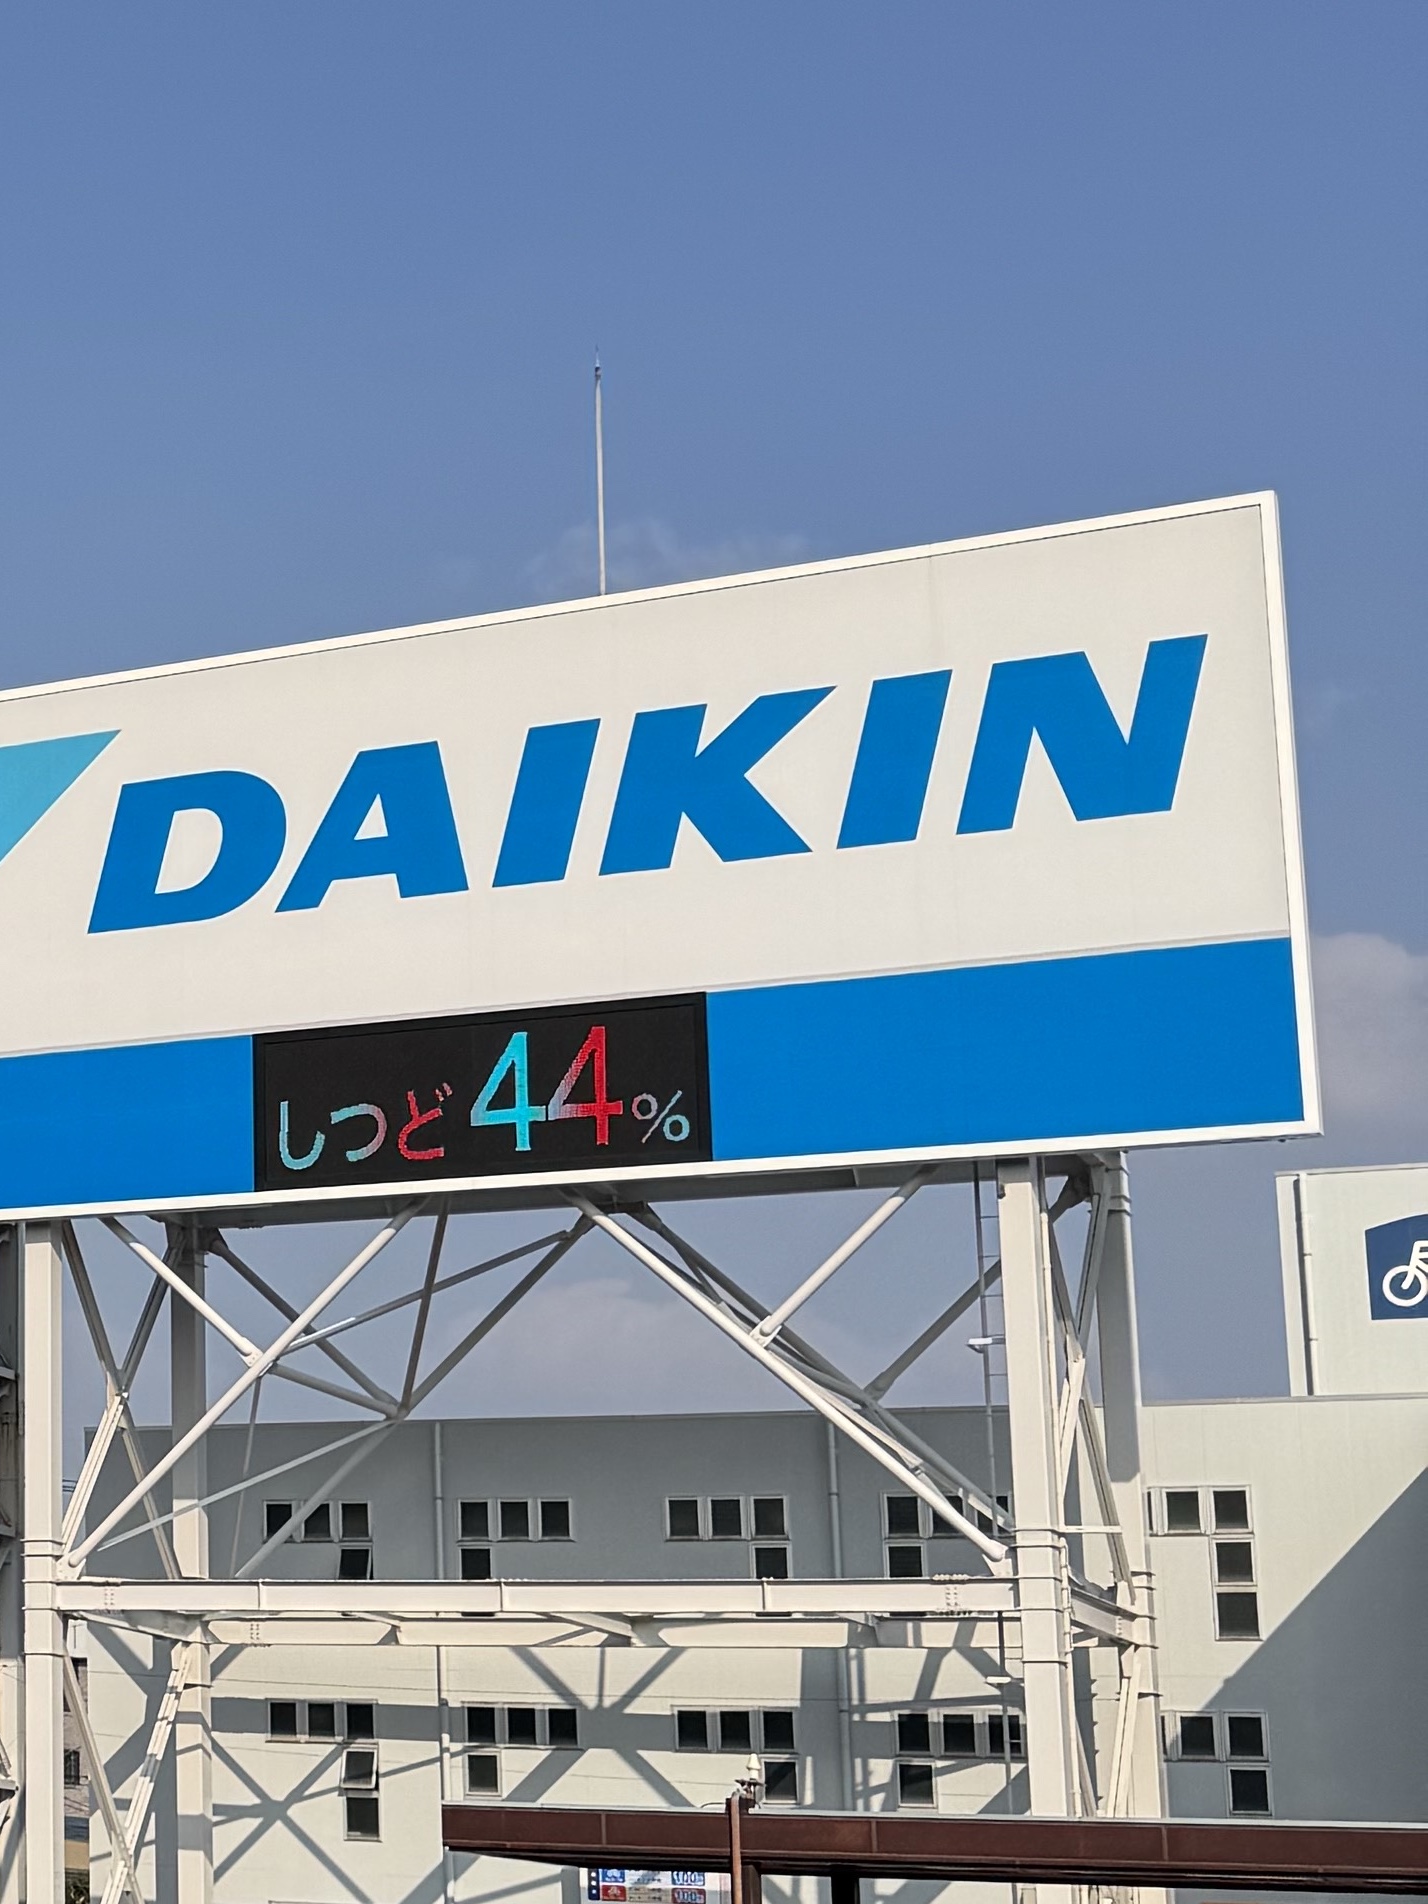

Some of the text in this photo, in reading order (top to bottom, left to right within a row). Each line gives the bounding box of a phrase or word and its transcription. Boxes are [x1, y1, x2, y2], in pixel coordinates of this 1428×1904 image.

[87, 633, 1209, 935] DAIKIN
[279, 1082, 452, 1170] しつど
